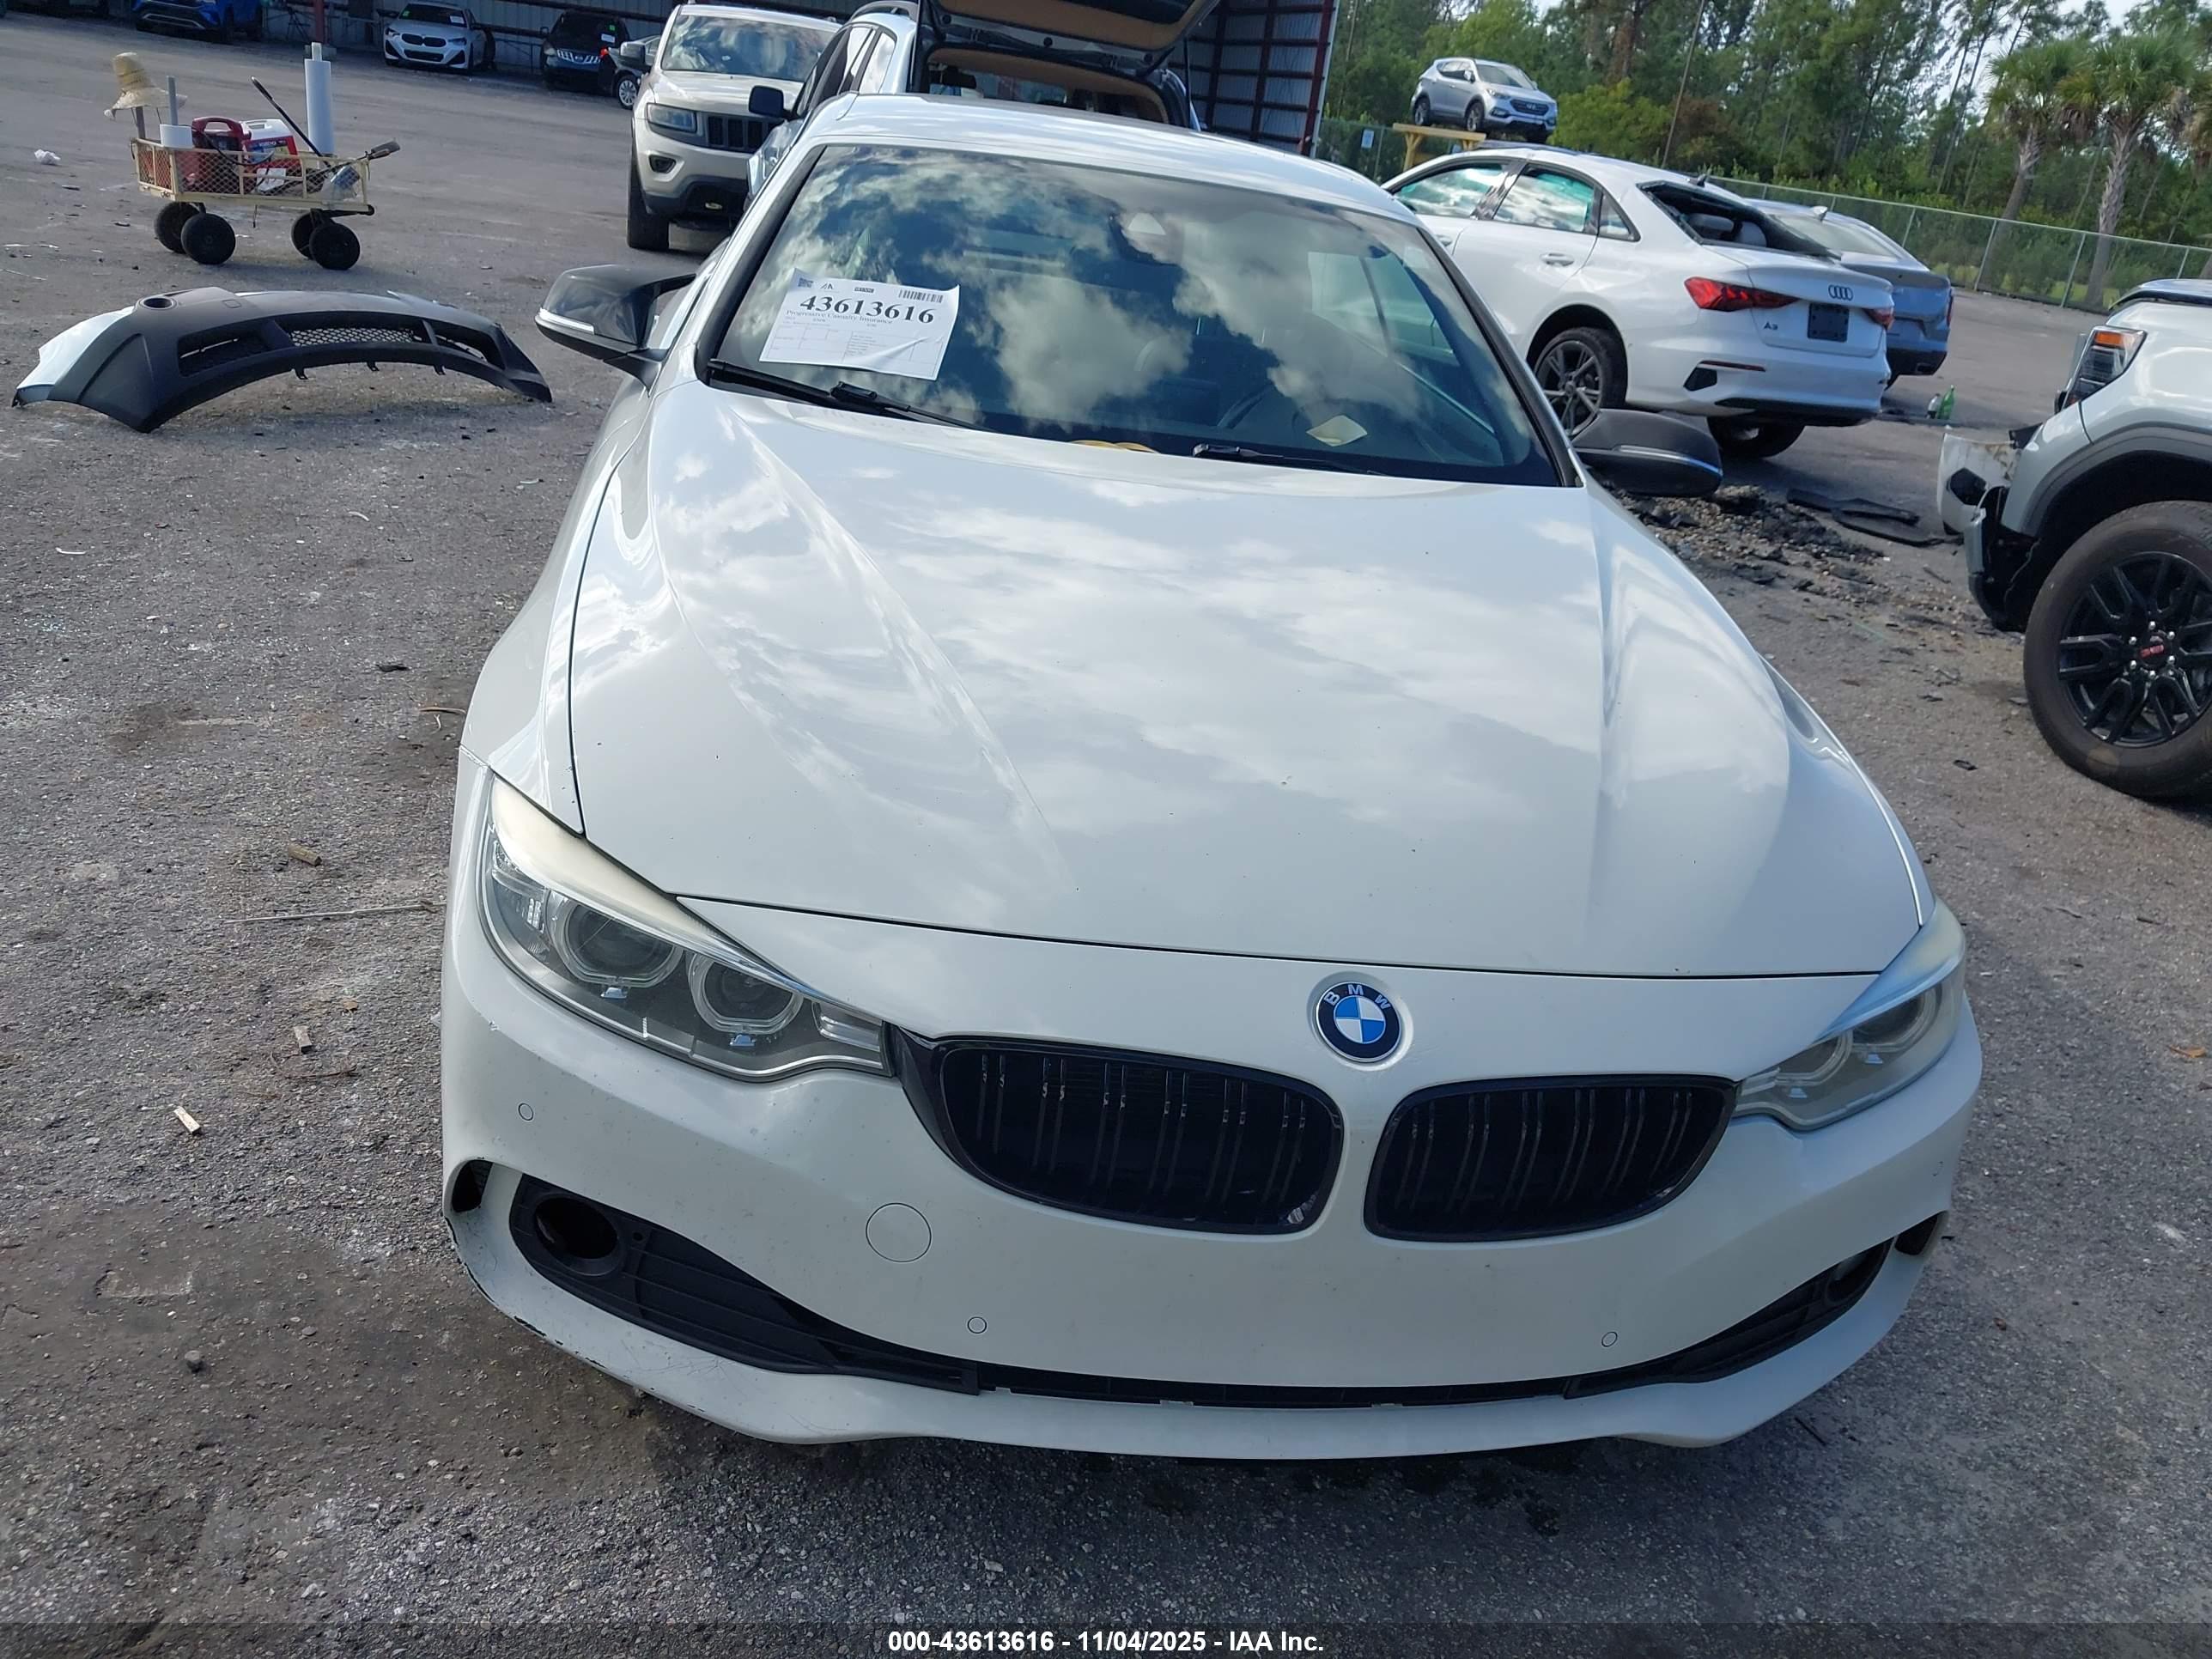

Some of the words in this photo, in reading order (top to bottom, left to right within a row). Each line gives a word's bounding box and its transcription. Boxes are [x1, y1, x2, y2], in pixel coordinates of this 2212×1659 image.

[786, 309, 826, 318] Progressive
[827, 313, 857, 321] Casualty
[859, 314, 893, 324] Insurance
[800, 295, 937, 324] 43613616
[1763, 321, 1778, 331] A3
[1323, 984, 1391, 1010] BMW
